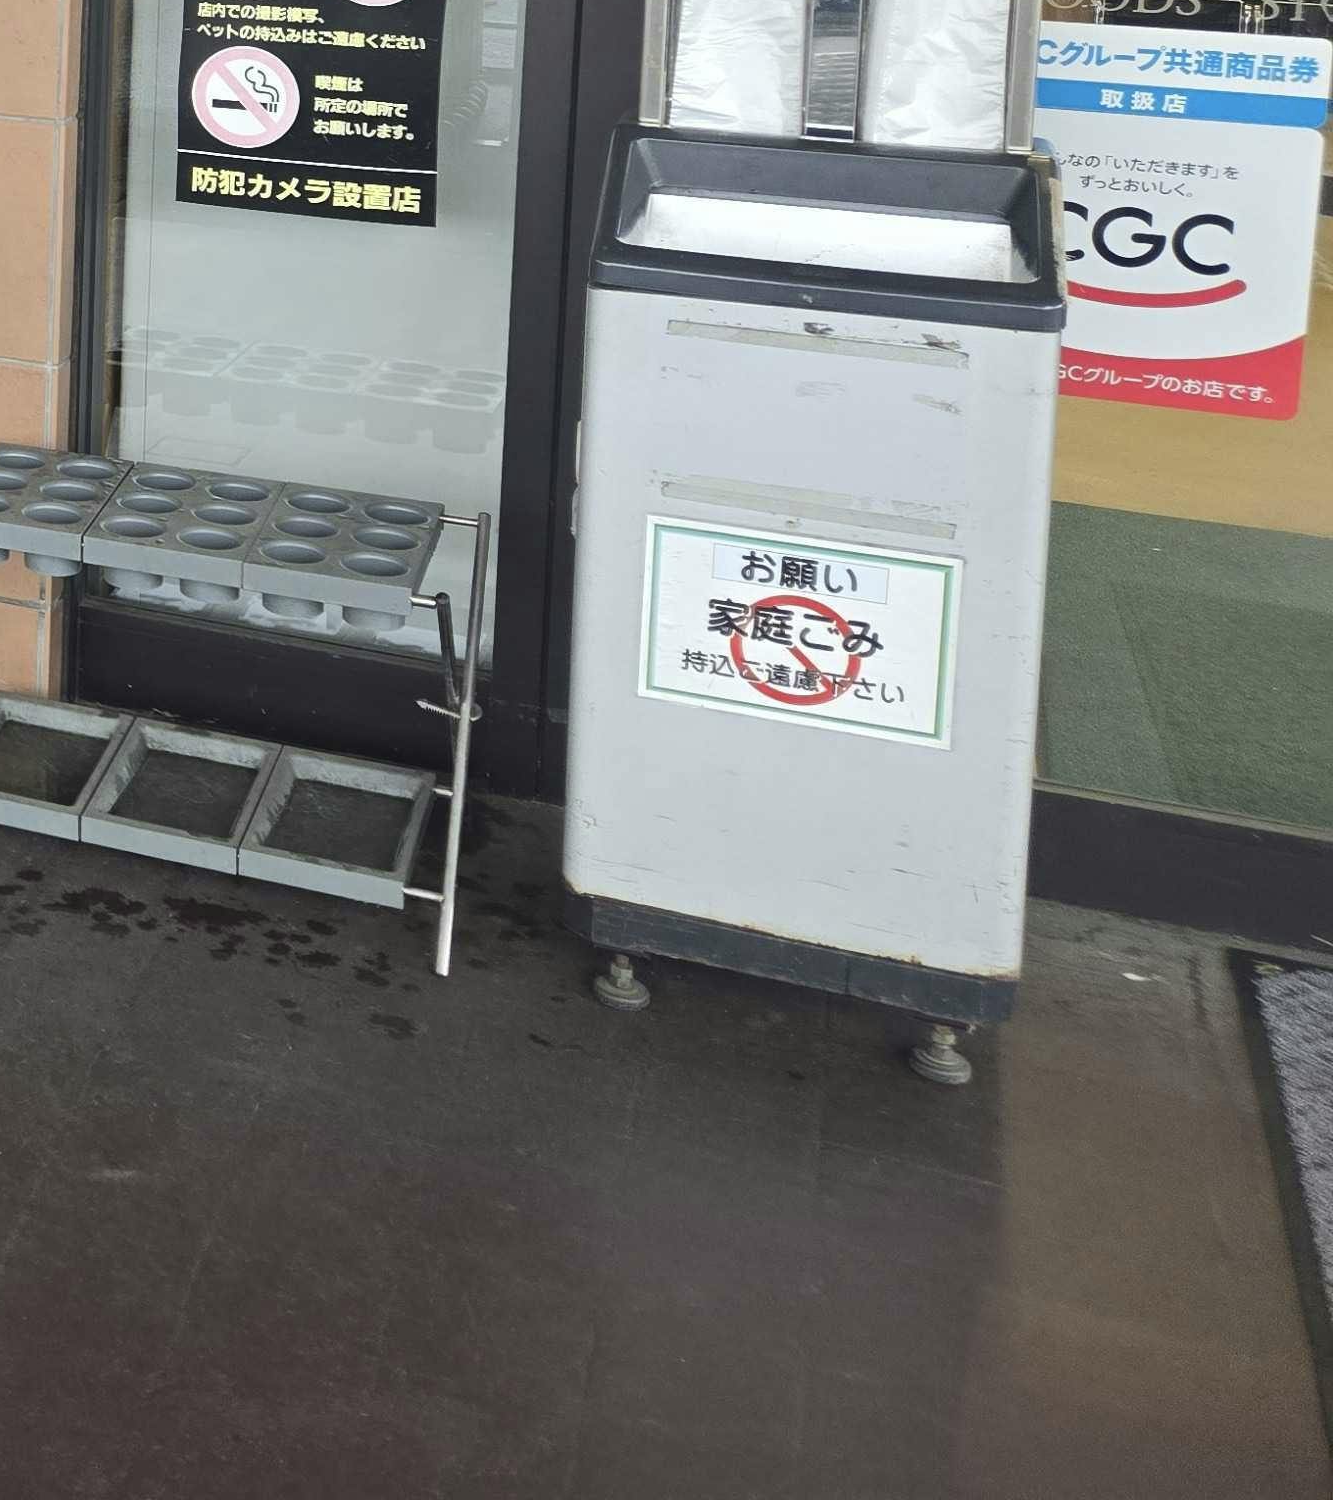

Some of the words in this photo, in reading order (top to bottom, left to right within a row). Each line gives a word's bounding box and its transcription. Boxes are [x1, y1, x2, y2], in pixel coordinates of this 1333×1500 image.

[197, 2, 326, 25] 店内での撮影模写、
[196, 24, 427, 51] ペットの持込みはご遠慮ください
[314, 74, 363, 93] 喫煙は
[313, 97, 409, 119] 所定の場所で
[1099, 88, 1188, 114] 取扱店
[313, 119, 415, 141] お願いします。
[190, 165, 422, 215] 防犯カメラ設置店
[1080, 175, 1194, 198] ずっとおいしく。
[740, 550, 859, 594] お願い
[706, 596, 885, 659] 家庭ごみ
[680, 647, 907, 705] 持込ご遠慮下さい
